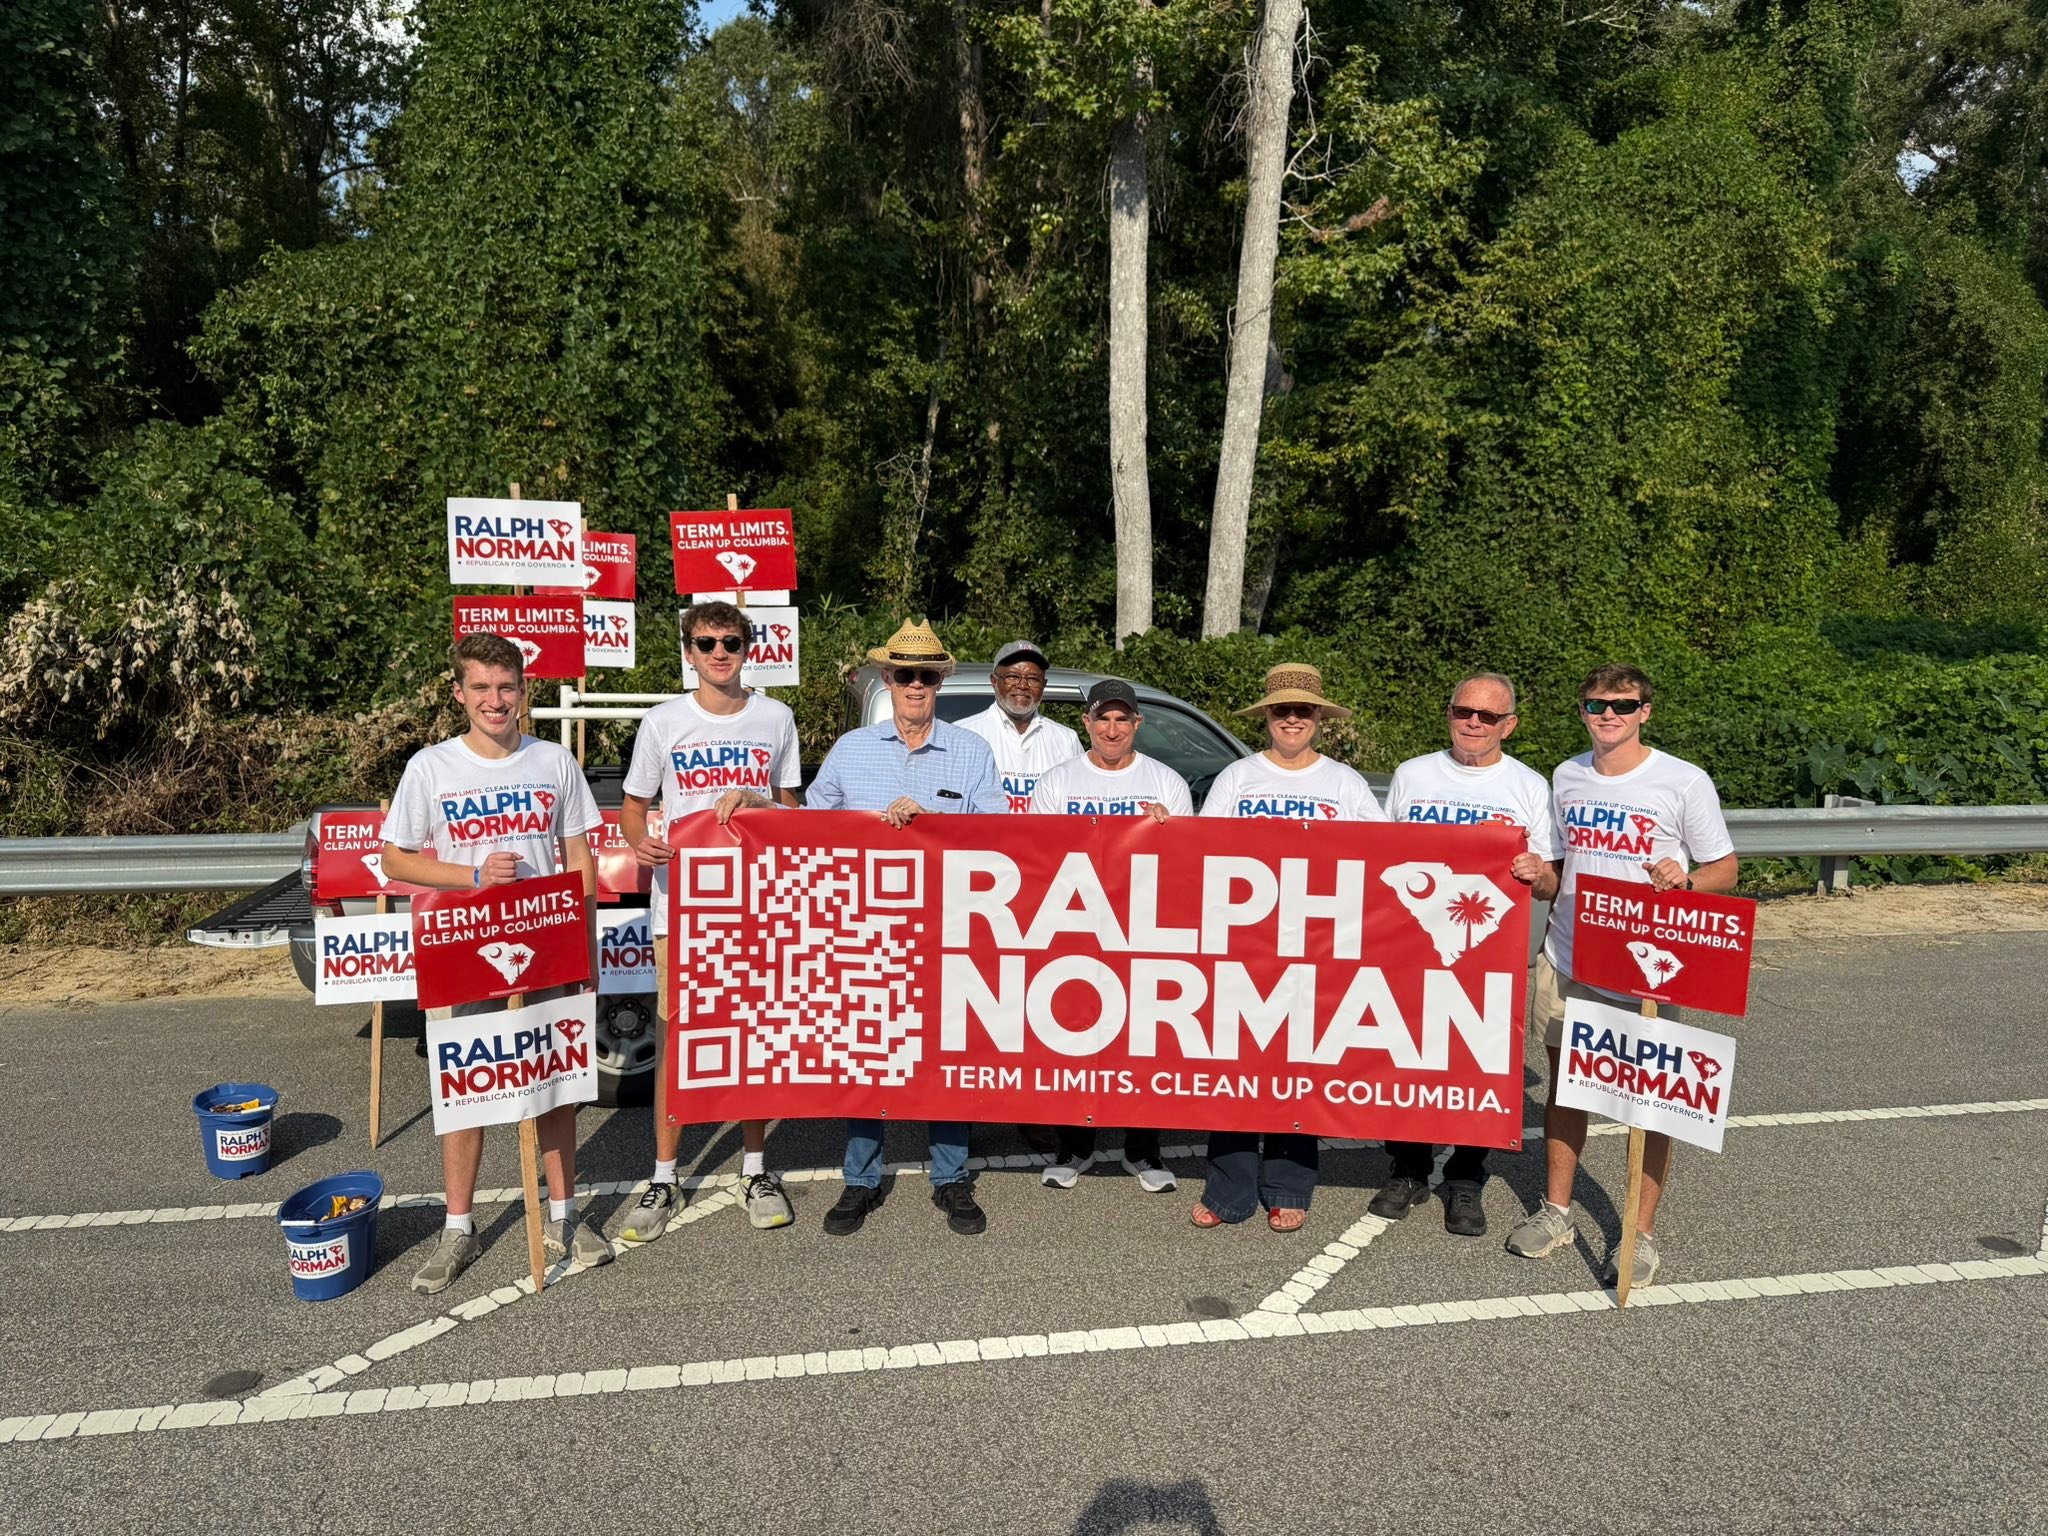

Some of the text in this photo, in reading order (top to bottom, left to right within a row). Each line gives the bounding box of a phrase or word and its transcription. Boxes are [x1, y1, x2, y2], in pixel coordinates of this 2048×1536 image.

[455, 516, 544, 538] RALPH
[676, 521, 790, 539] TERM LIMITS.
[456, 537, 575, 561] NORMAN
[582, 540, 632, 555] LIMITS.
[678, 537, 790, 550] CLEAN UP COLUMBIA.
[583, 553, 632, 564] COLUMBIA.
[458, 608, 509, 622] TERM
[515, 608, 580, 623] LIMITS.
[459, 624, 580, 634] CLEAN UP COLUMBIA.
[671, 747, 748, 771] RALPH
[676, 767, 770, 789] NORMAN
[440, 792, 458, 800] TERM
[459, 788, 484, 797] LIMITS.
[485, 785, 509, 793] CLEAN
[441, 791, 531, 822] RALPH
[1238, 799, 1315, 818] RALPH
[1409, 806, 1488, 824] RALPH
[1449, 800, 1471, 808] CLEAN
[1586, 800, 1608, 808] CLEAN
[324, 824, 373, 840] TERM
[447, 812, 554, 842] NORMAN
[324, 841, 361, 851] CLEAN
[364, 840, 379, 849] UP
[459, 838, 499, 848] REPUBLICAN
[500, 835, 514, 843] FOR
[1567, 826, 1655, 855] ORMAN
[1604, 852, 1643, 862] GOVERNOR
[419, 890, 579, 930] TERM LIMITS.
[943, 850, 1365, 959] RALPH
[1581, 890, 1746, 936] TERM LIMITS.
[420, 911, 580, 946] CLEAN UP COLUMBIA.
[601, 926, 653, 947] RAL
[1580, 912, 1744, 951] CLEAN UP COLUMBIA.
[323, 930, 408, 956] RALPH
[323, 952, 416, 978] NORMA
[601, 946, 656, 968] NOR
[332, 978, 372, 986] REPUBLICAN
[609, 968, 653, 976] REPUBLICAN
[940, 954, 1513, 1075] NORMAN
[438, 1023, 552, 1071] RALPH
[1571, 1021, 1683, 1074] RALPH
[440, 1042, 588, 1099] NORMAN
[1568, 1048, 1721, 1115] NORMAN
[455, 1073, 578, 1107] REPUBLICAN FOR GOVERNOR
[941, 1065, 1511, 1114] TERM LIMITS. CLEAN UP COLUMBIA.
[1579, 1079, 1704, 1122] REPUBLICAN FOR GOVERNOR
[220, 1131, 261, 1145] RALPH
[221, 1138, 269, 1155] NORMAN
